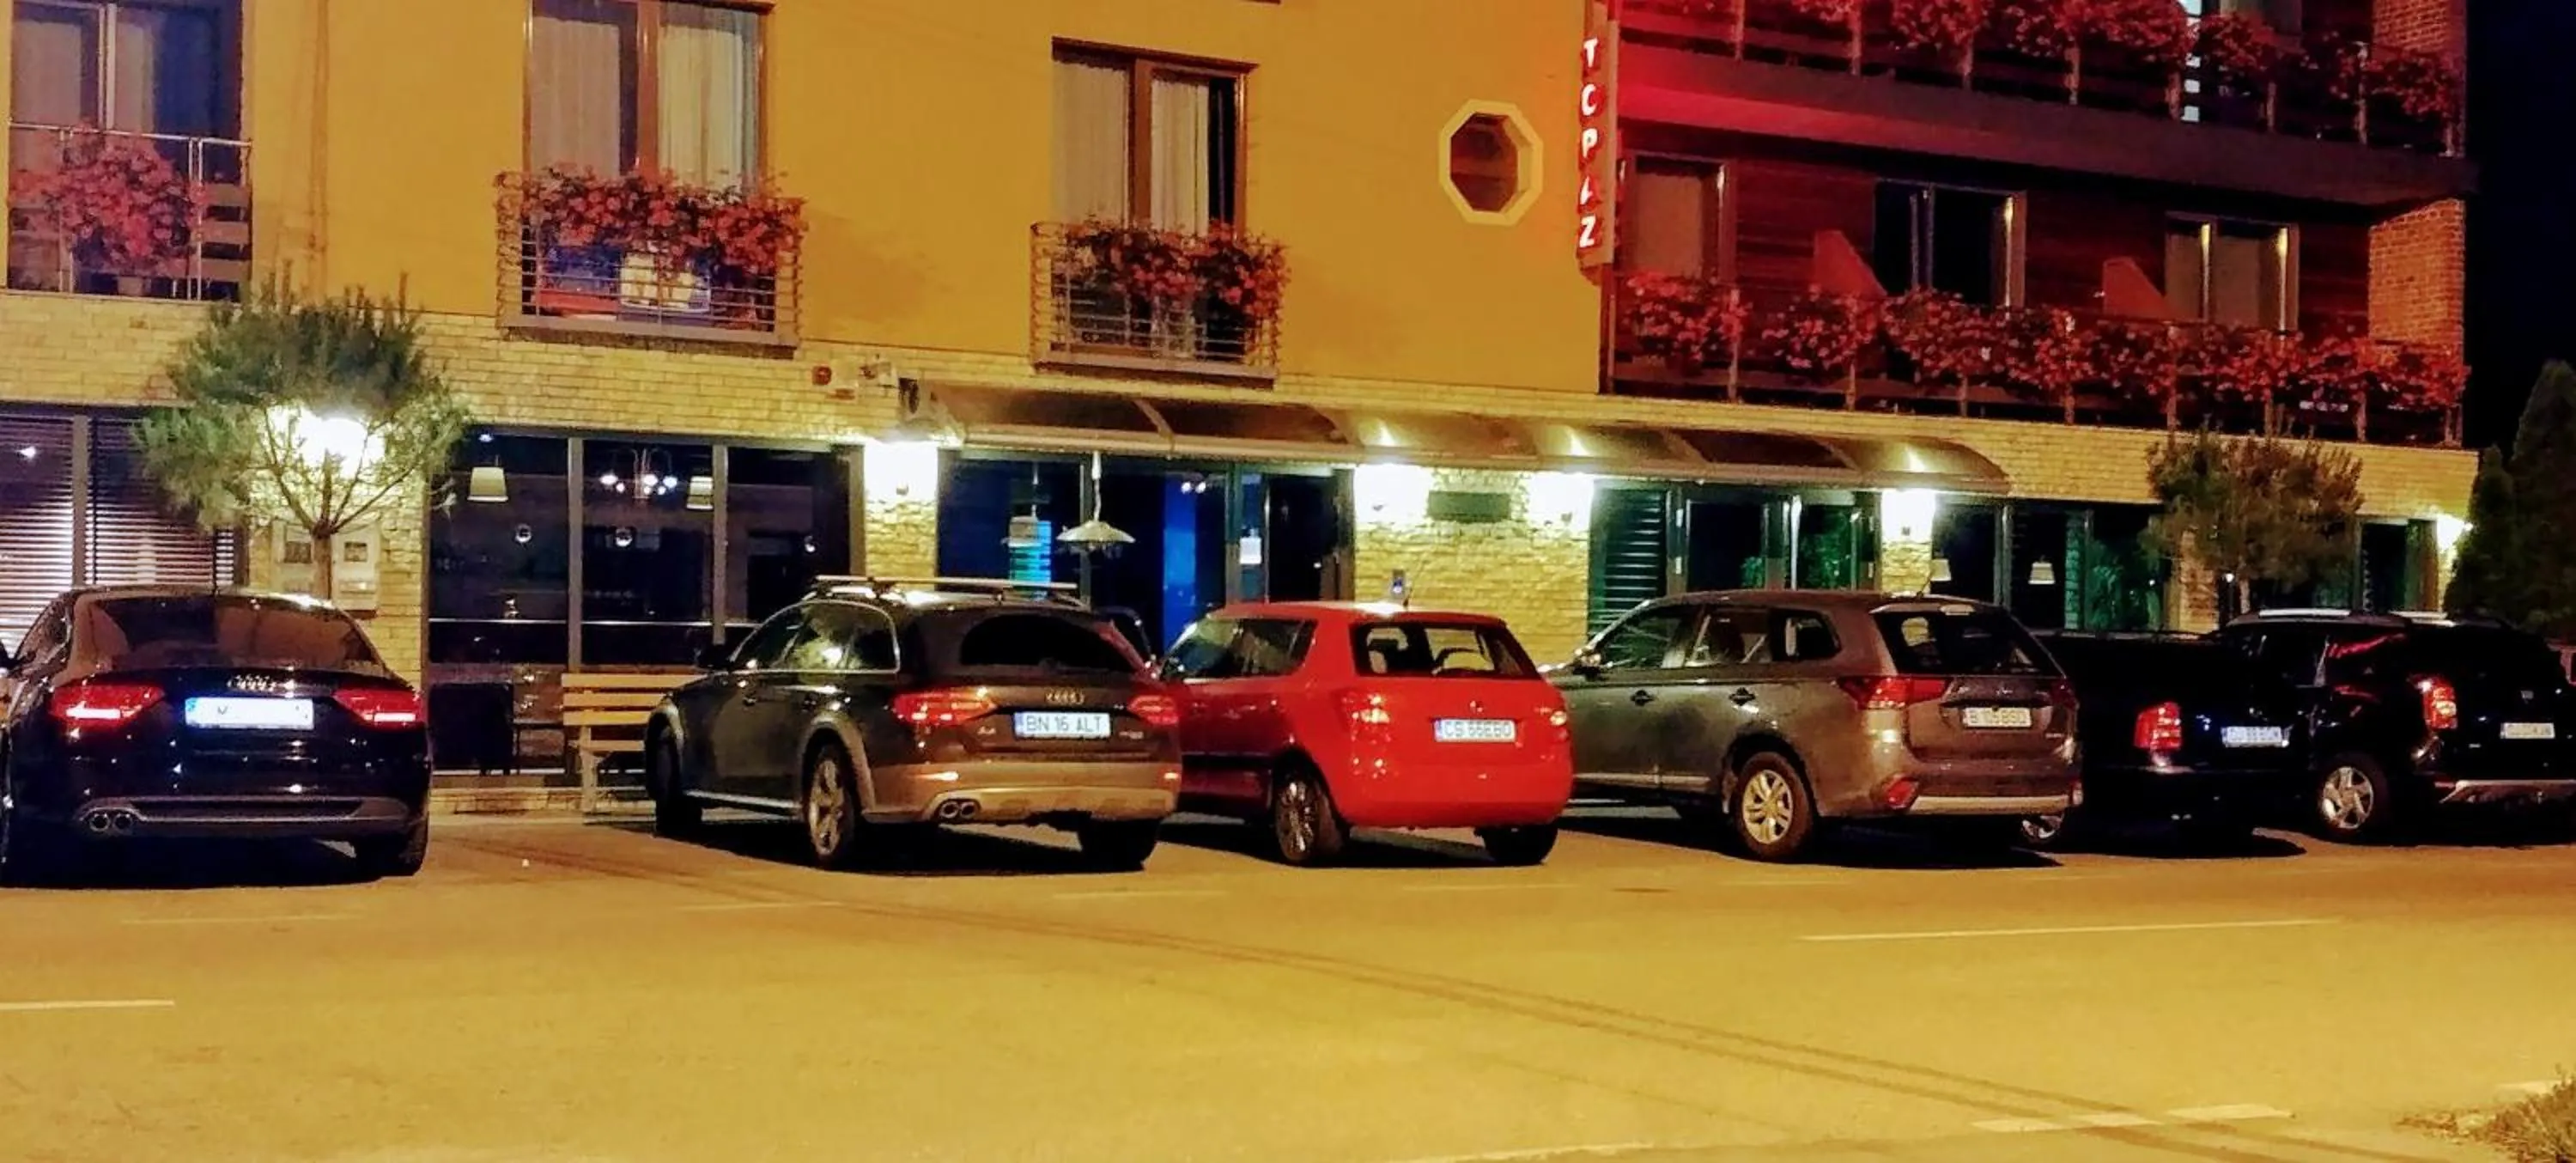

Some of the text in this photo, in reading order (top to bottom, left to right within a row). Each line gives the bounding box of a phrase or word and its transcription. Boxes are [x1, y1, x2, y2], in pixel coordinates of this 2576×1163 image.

[1025, 715, 1103, 733] BN 16 ALT
